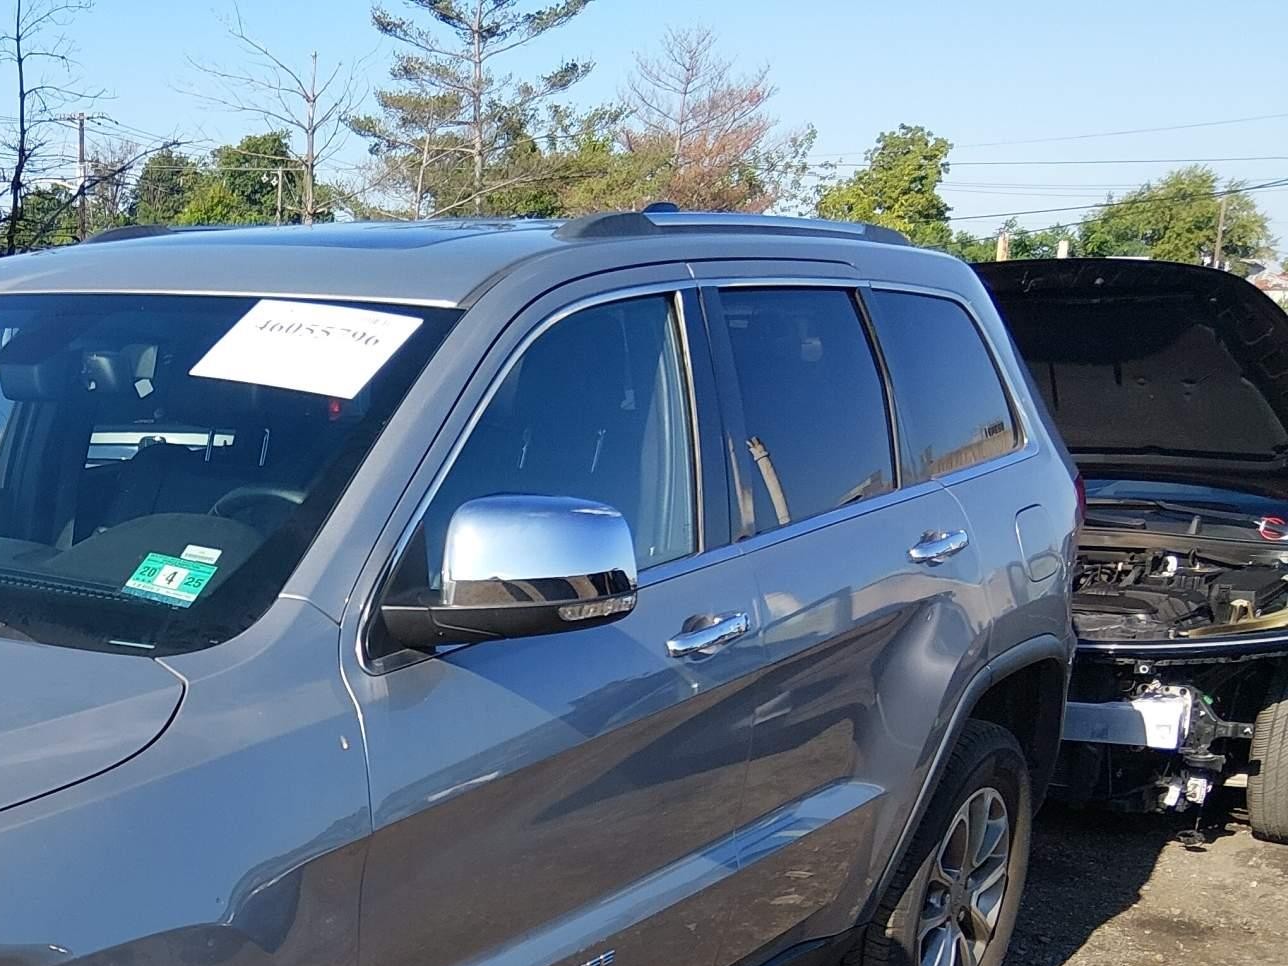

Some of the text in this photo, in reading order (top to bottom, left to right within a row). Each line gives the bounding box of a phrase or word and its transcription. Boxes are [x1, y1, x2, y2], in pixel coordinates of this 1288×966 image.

[140, 565, 204, 588] 20 4 25
